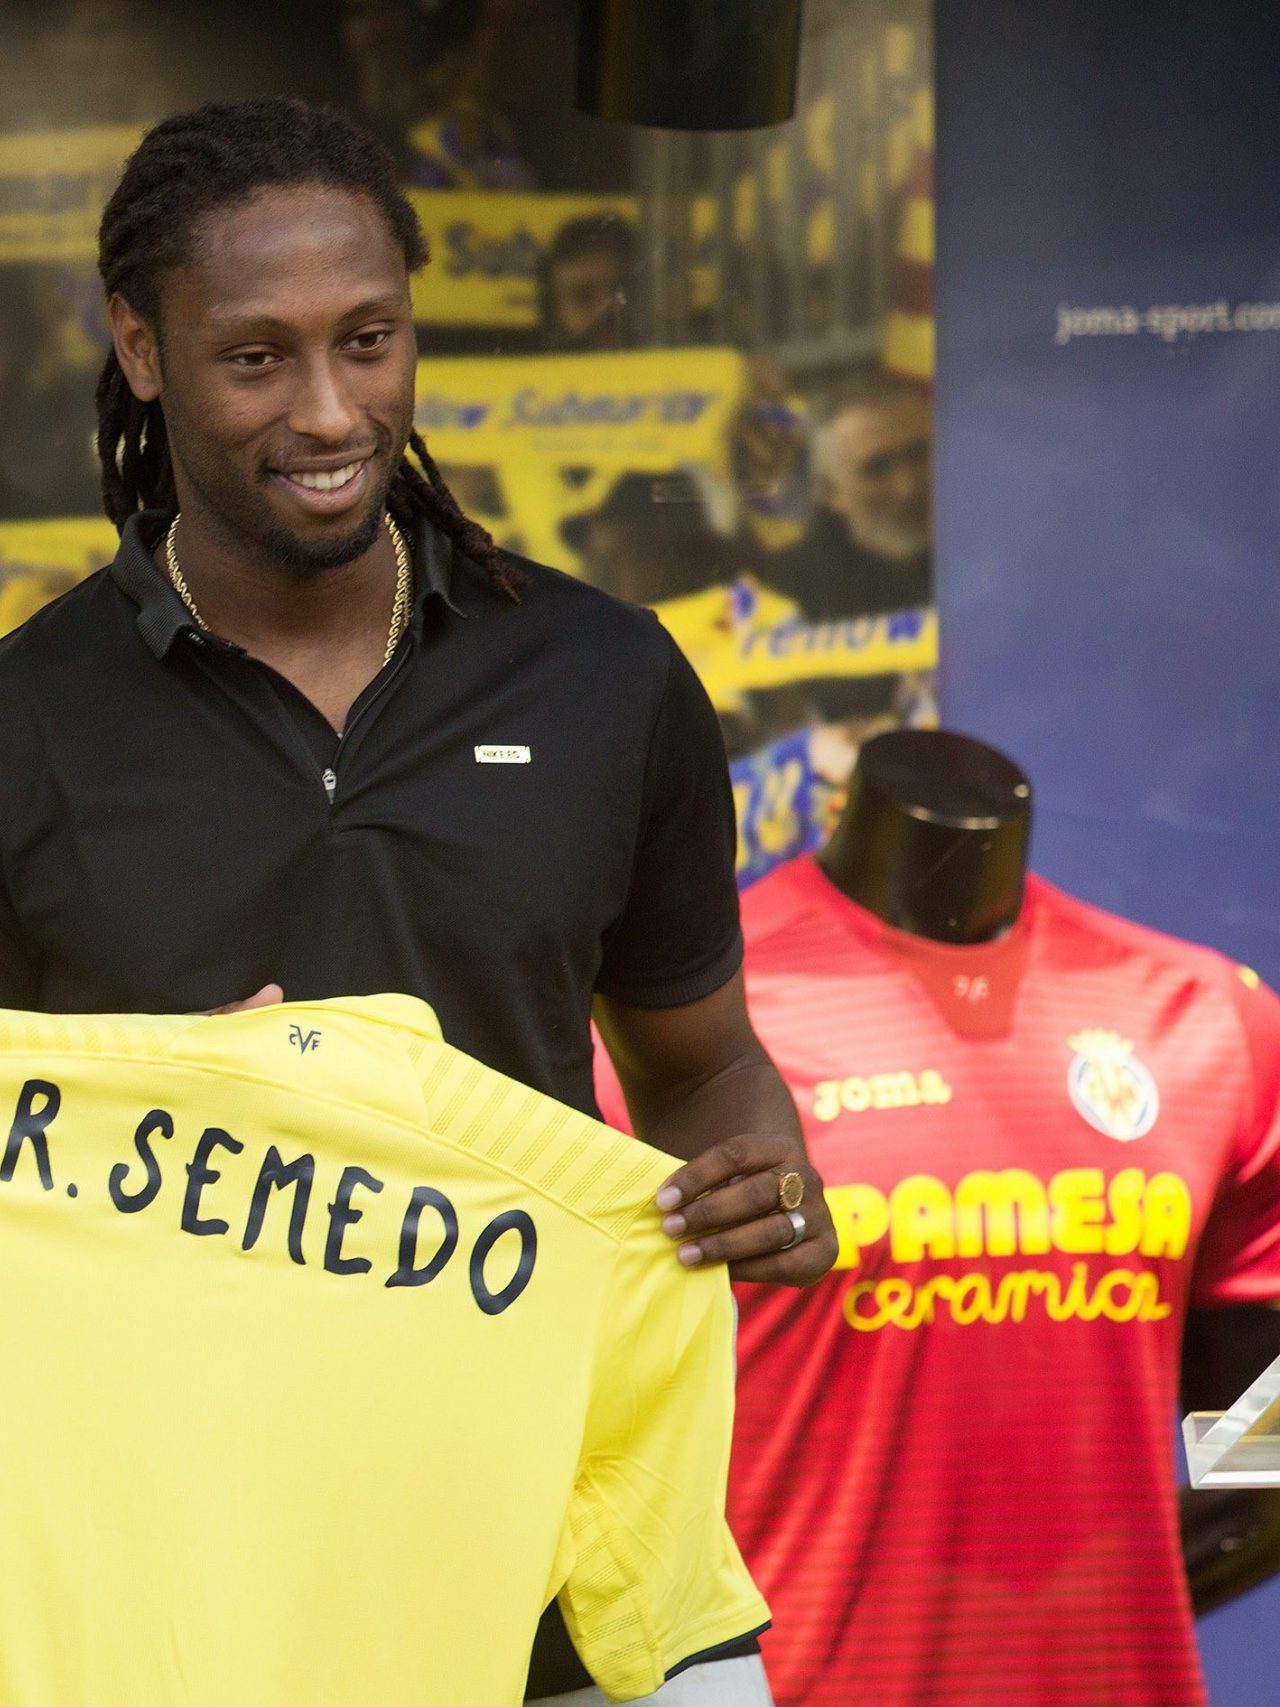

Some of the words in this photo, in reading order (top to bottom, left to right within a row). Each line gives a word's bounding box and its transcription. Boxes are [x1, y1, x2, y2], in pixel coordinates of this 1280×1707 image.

[0, 1078, 78, 1198] R.
[108, 1108, 538, 1316] SEMEDO
[824, 1167, 1192, 1271] PAMESA
